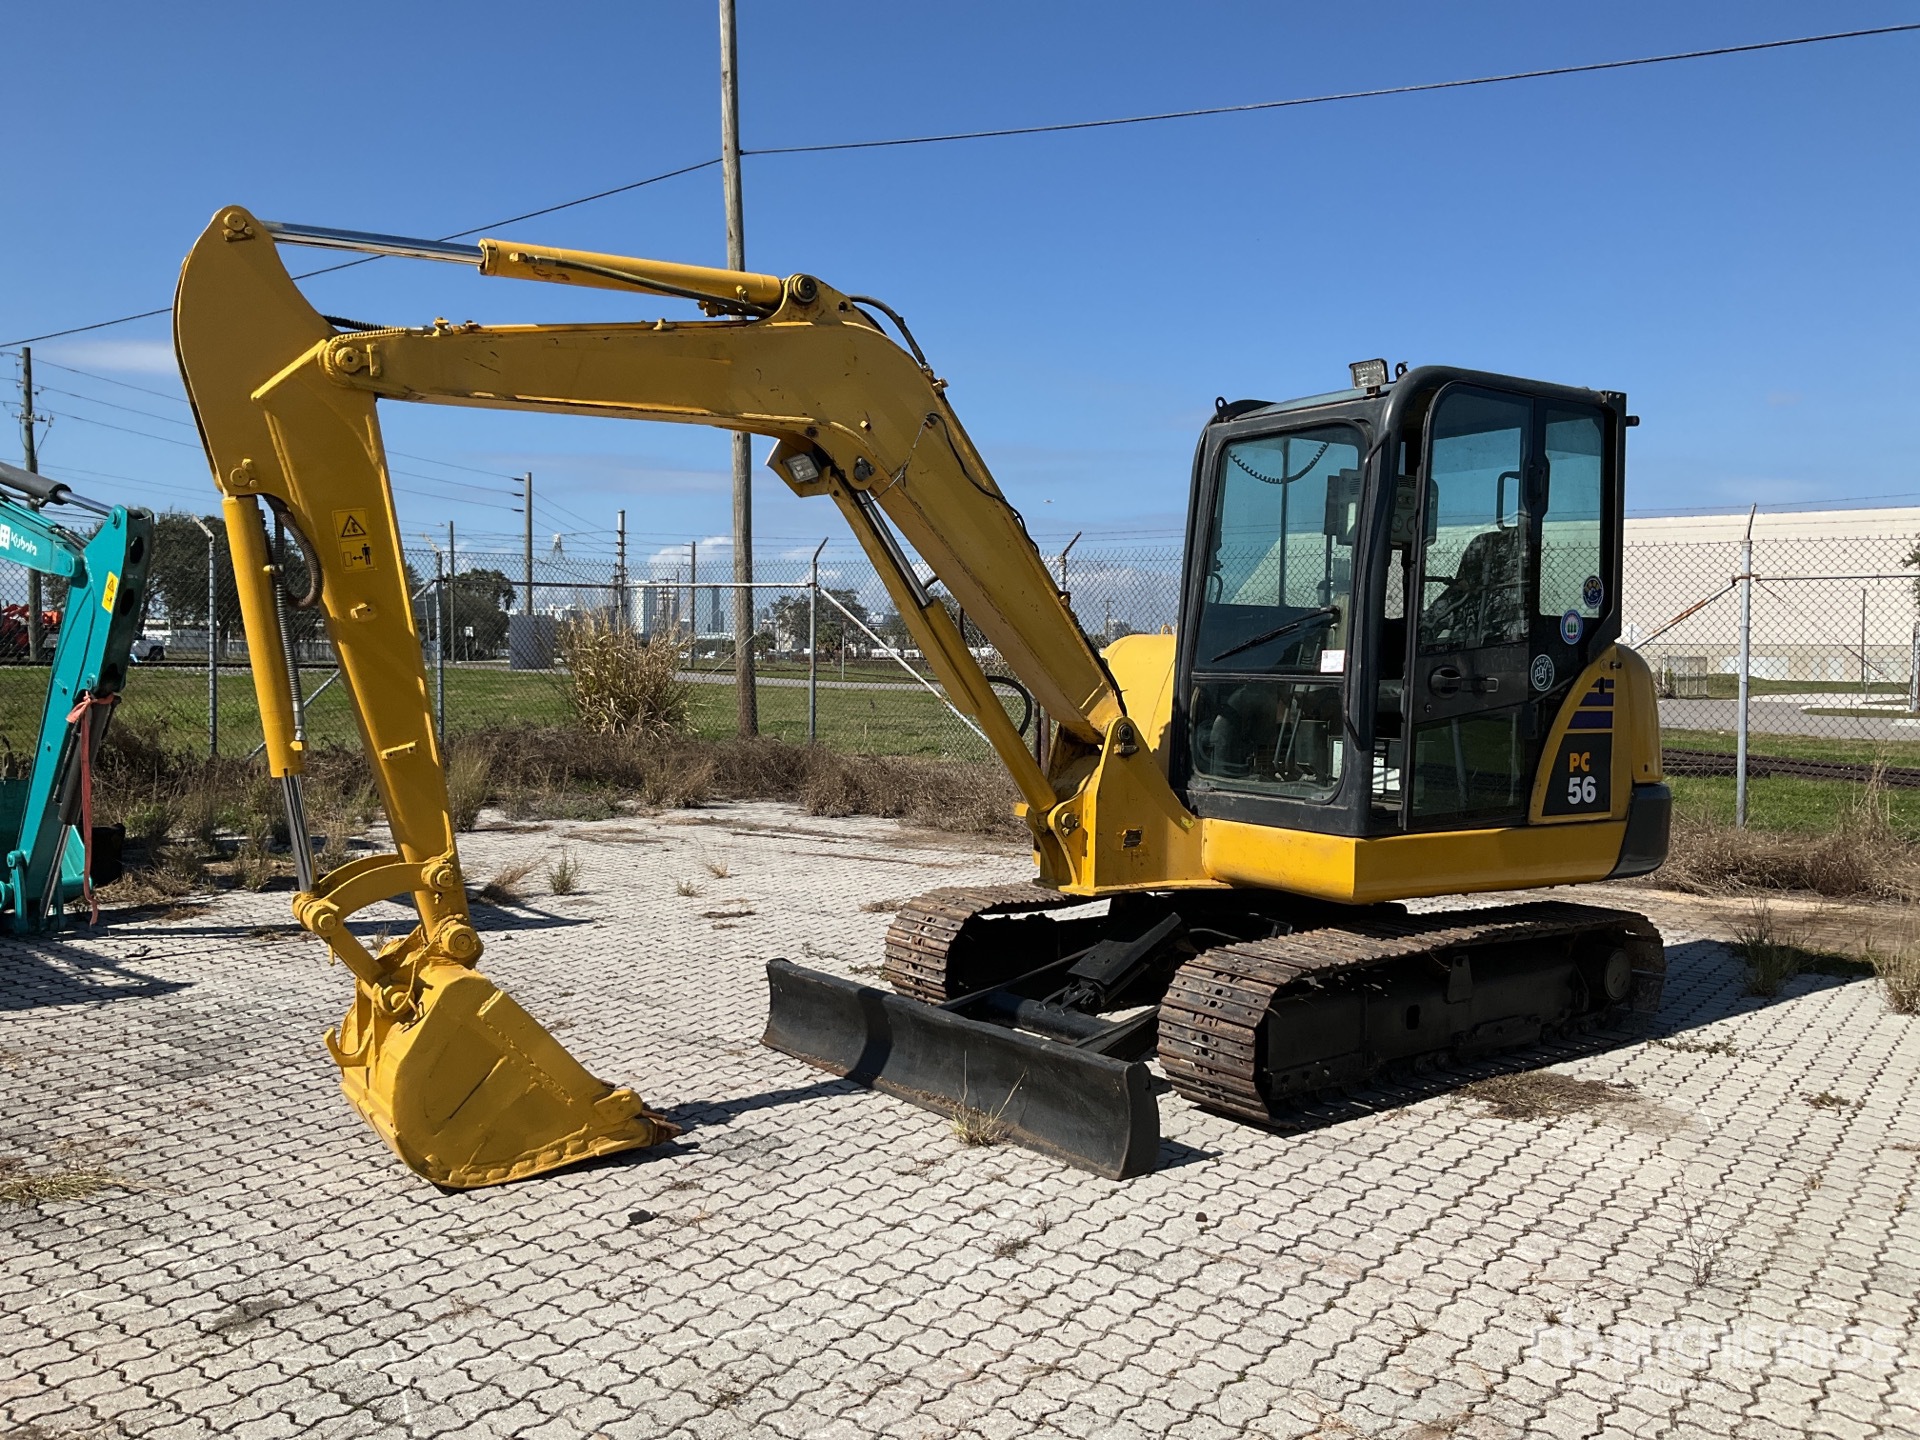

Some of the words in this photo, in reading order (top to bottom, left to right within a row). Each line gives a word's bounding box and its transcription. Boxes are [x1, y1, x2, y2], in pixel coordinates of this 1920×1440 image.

[10, 531, 37, 556] Kubota
[1569, 751, 1590, 773] PC
[1567, 775, 1596, 805] 56
